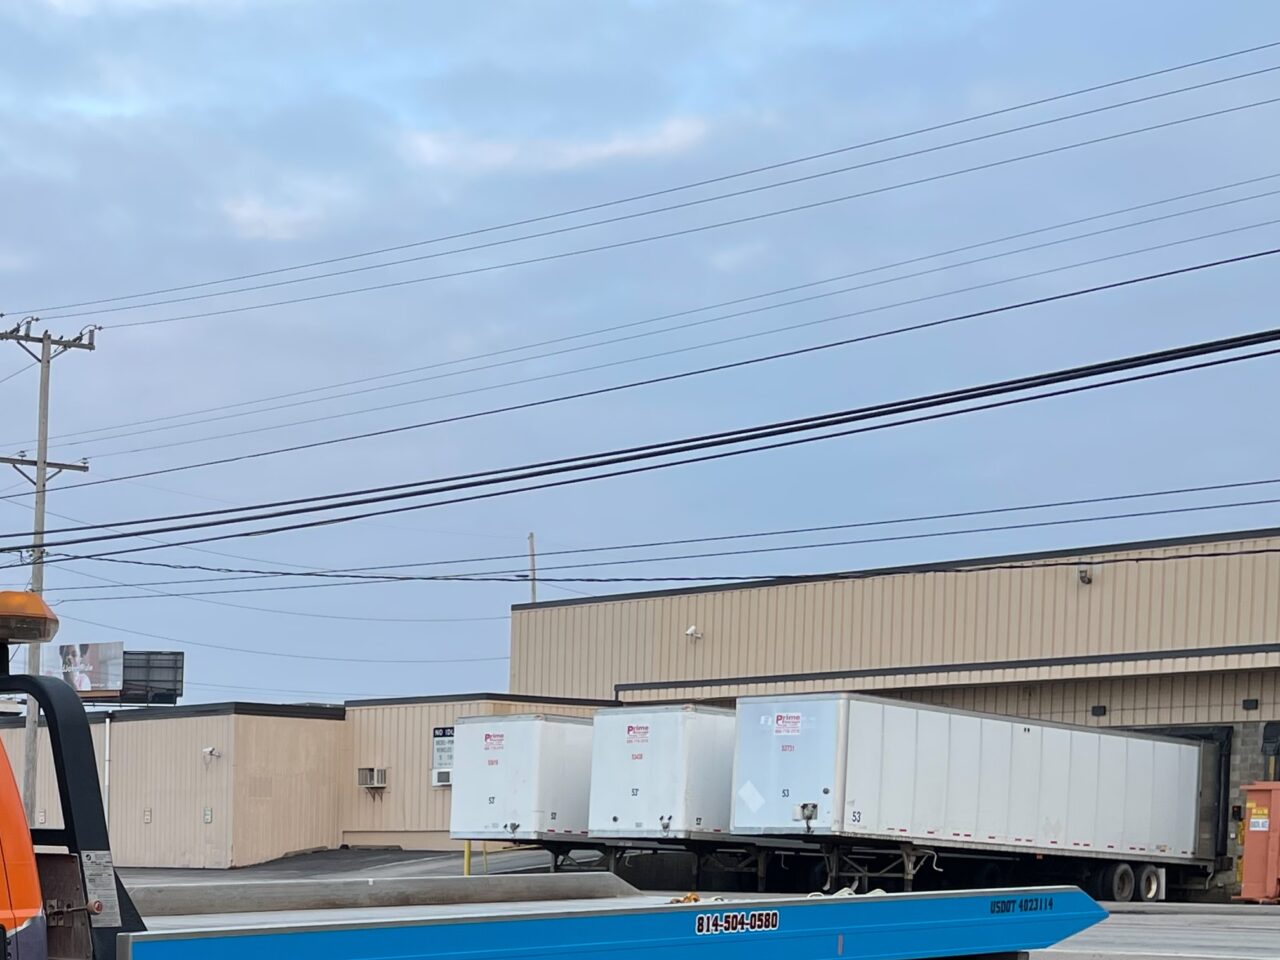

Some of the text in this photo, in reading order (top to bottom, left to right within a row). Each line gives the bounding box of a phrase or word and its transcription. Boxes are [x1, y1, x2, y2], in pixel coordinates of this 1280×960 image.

[776, 714, 801, 725] Prime
[627, 725, 649, 735] Prime
[990, 897, 1054, 914] USDOT 4023114
[696, 910, 779, 935] 814-504-0580
